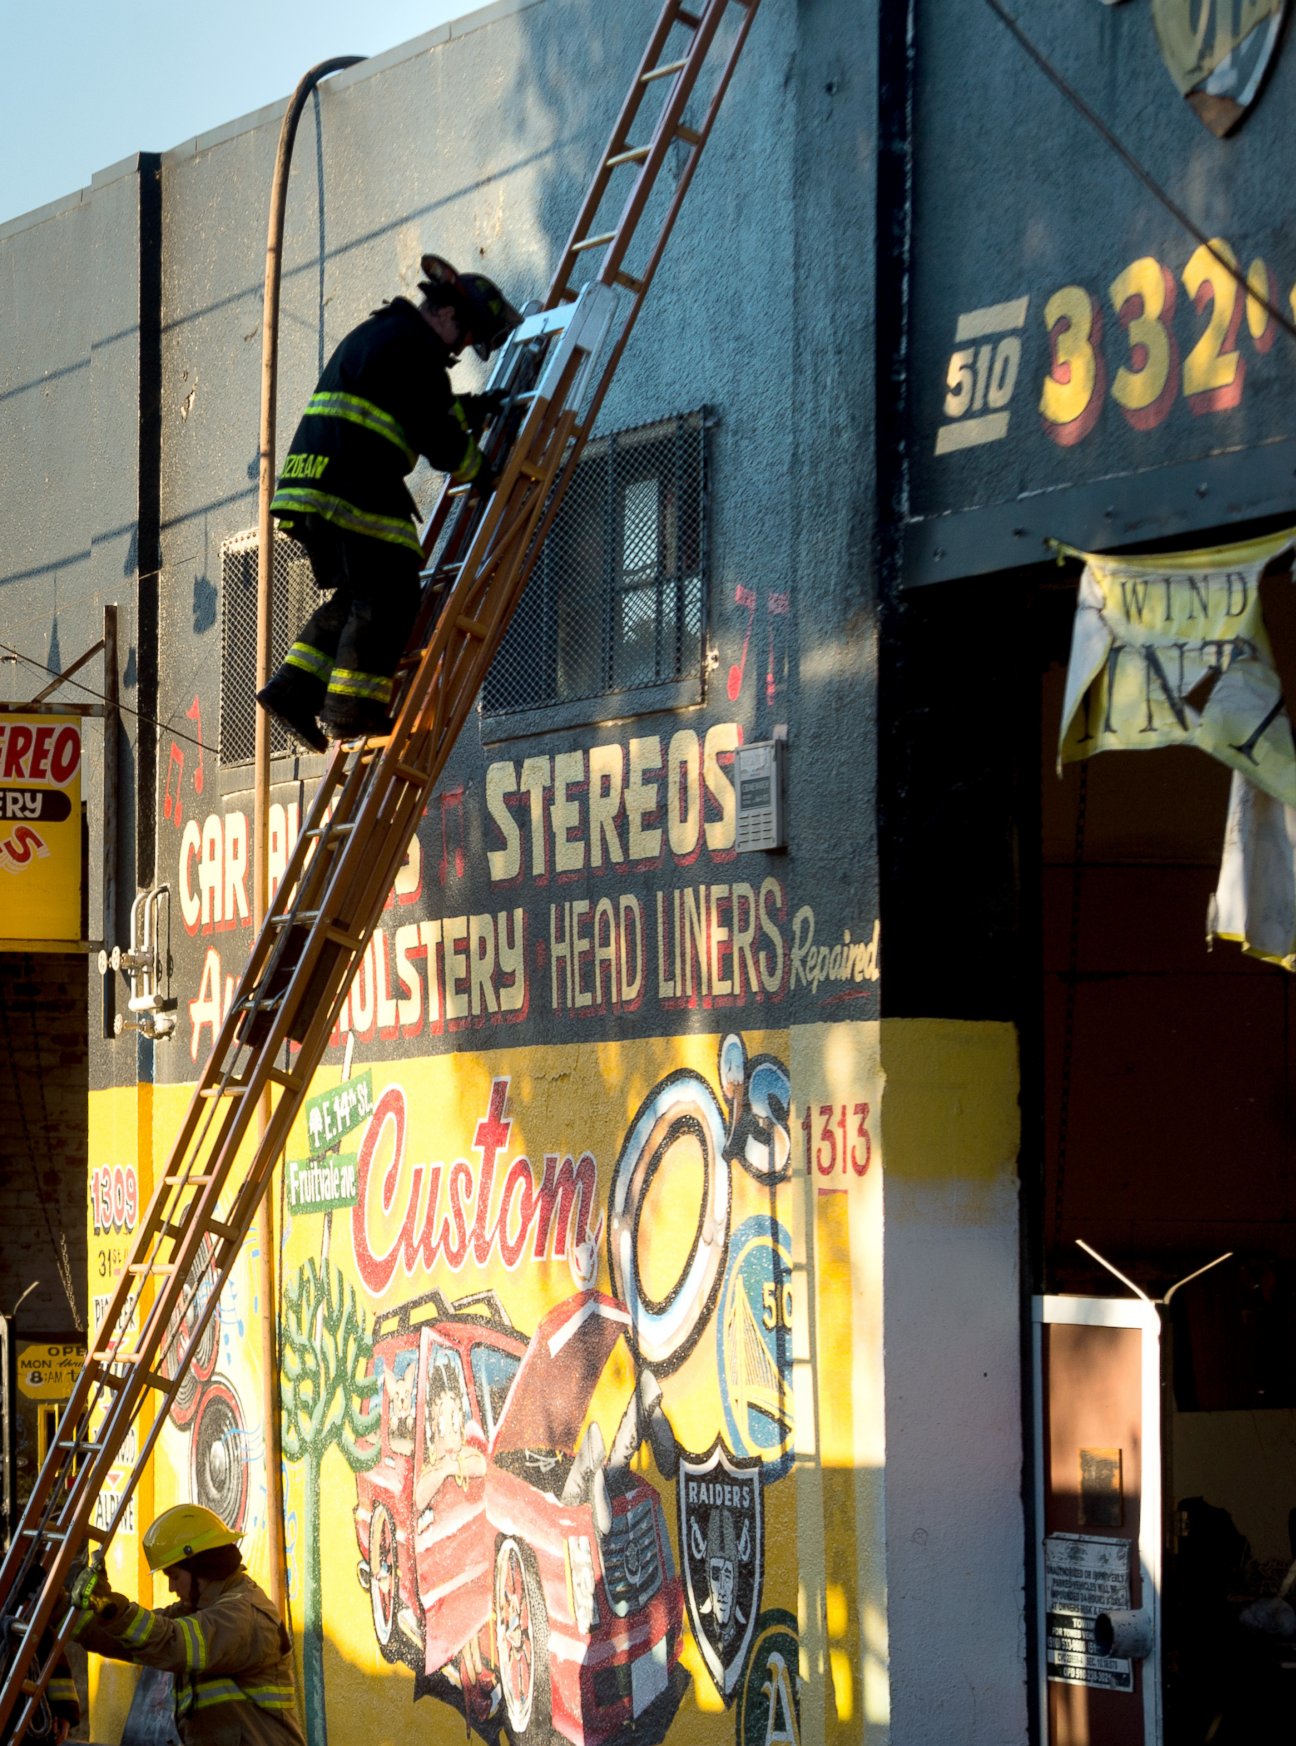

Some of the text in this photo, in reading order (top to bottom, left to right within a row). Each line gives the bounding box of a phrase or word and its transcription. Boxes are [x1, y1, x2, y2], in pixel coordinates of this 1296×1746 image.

[942, 336, 1023, 418] 510
[1121, 571, 1249, 624] WIND
[178, 810, 252, 936] CAR
[486, 723, 740, 885] STEREOS
[550, 894, 644, 1010] HEAD
[657, 876, 786, 1004] LINERS
[801, 1102, 872, 1177] 1313
[90, 1164, 139, 1236] 1309
[289, 1160, 340, 1206] Fruitvale
[351, 1074, 603, 1298] Custom
[20, 1360, 52, 1370] MON
[689, 1481, 750, 1508] RAIDERS
